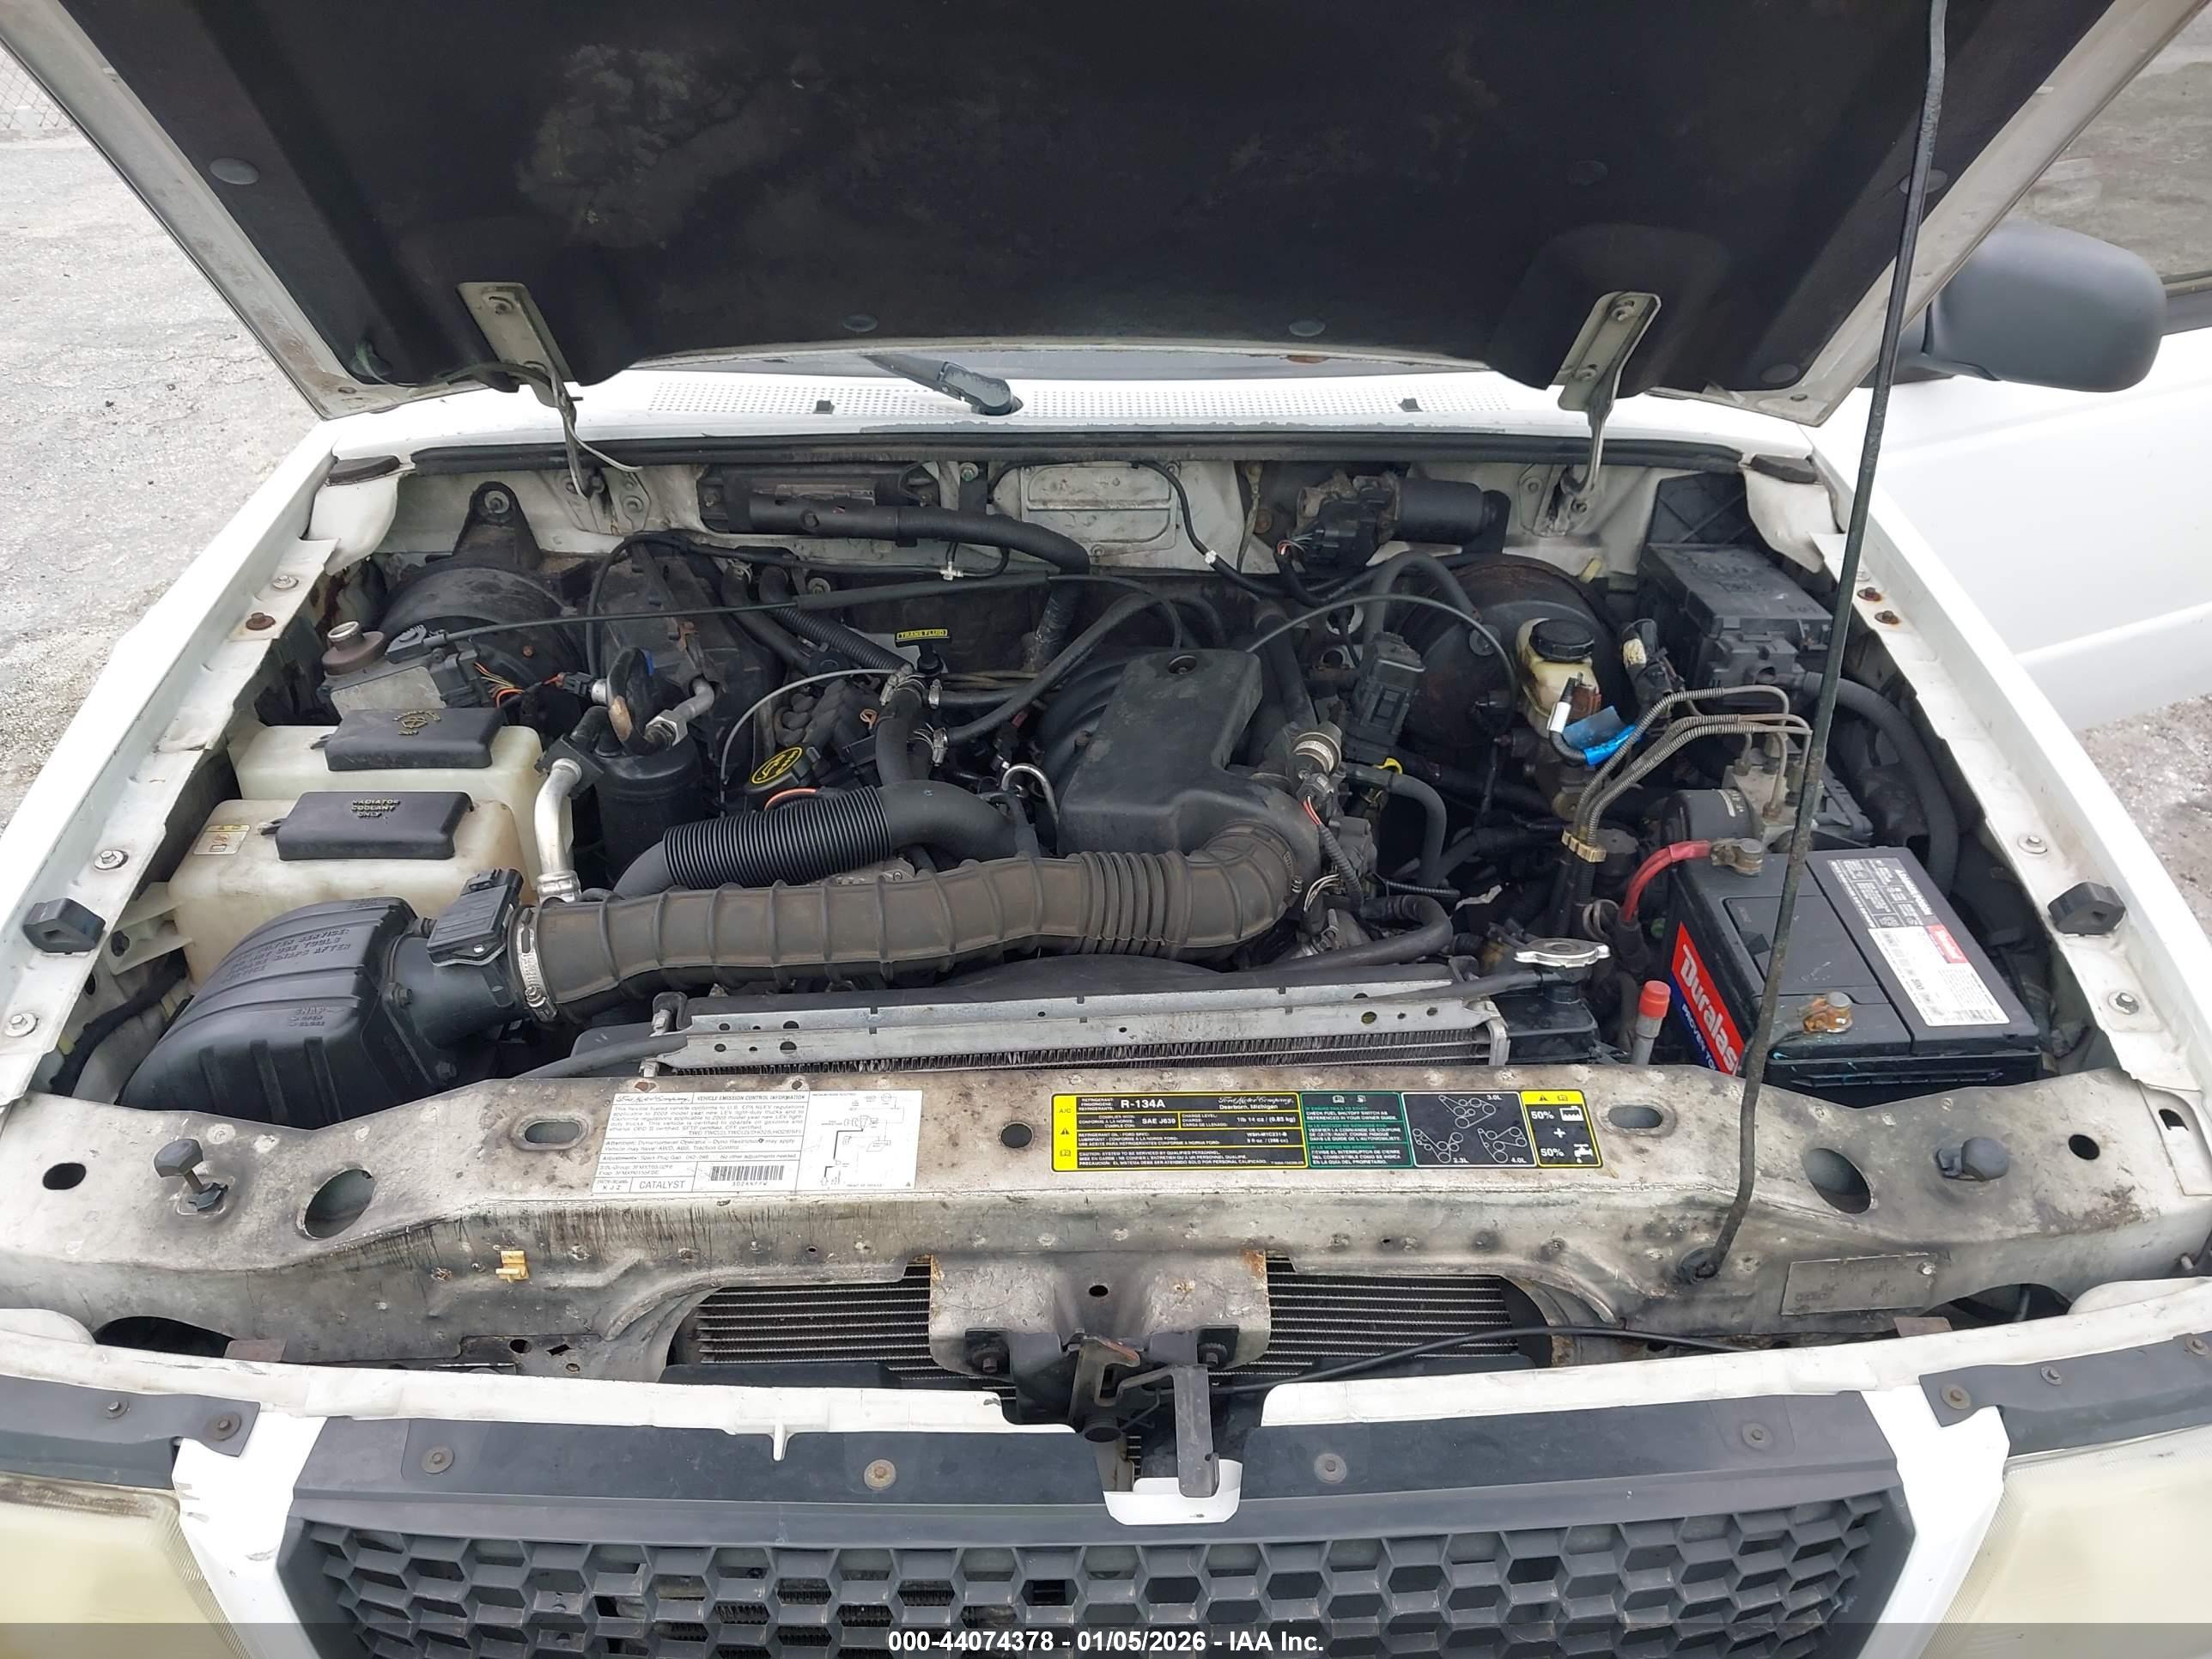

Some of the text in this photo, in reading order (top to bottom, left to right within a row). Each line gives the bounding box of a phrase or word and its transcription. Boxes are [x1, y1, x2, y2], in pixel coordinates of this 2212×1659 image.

[1681, 1003, 1706, 1051] PROVEN
[1121, 1099, 1166, 1108] R-134A
[1531, 1111, 1554, 1119] 50%
[1540, 1148, 1564, 1156] 50%
[639, 1180, 686, 1189] CATALYST
